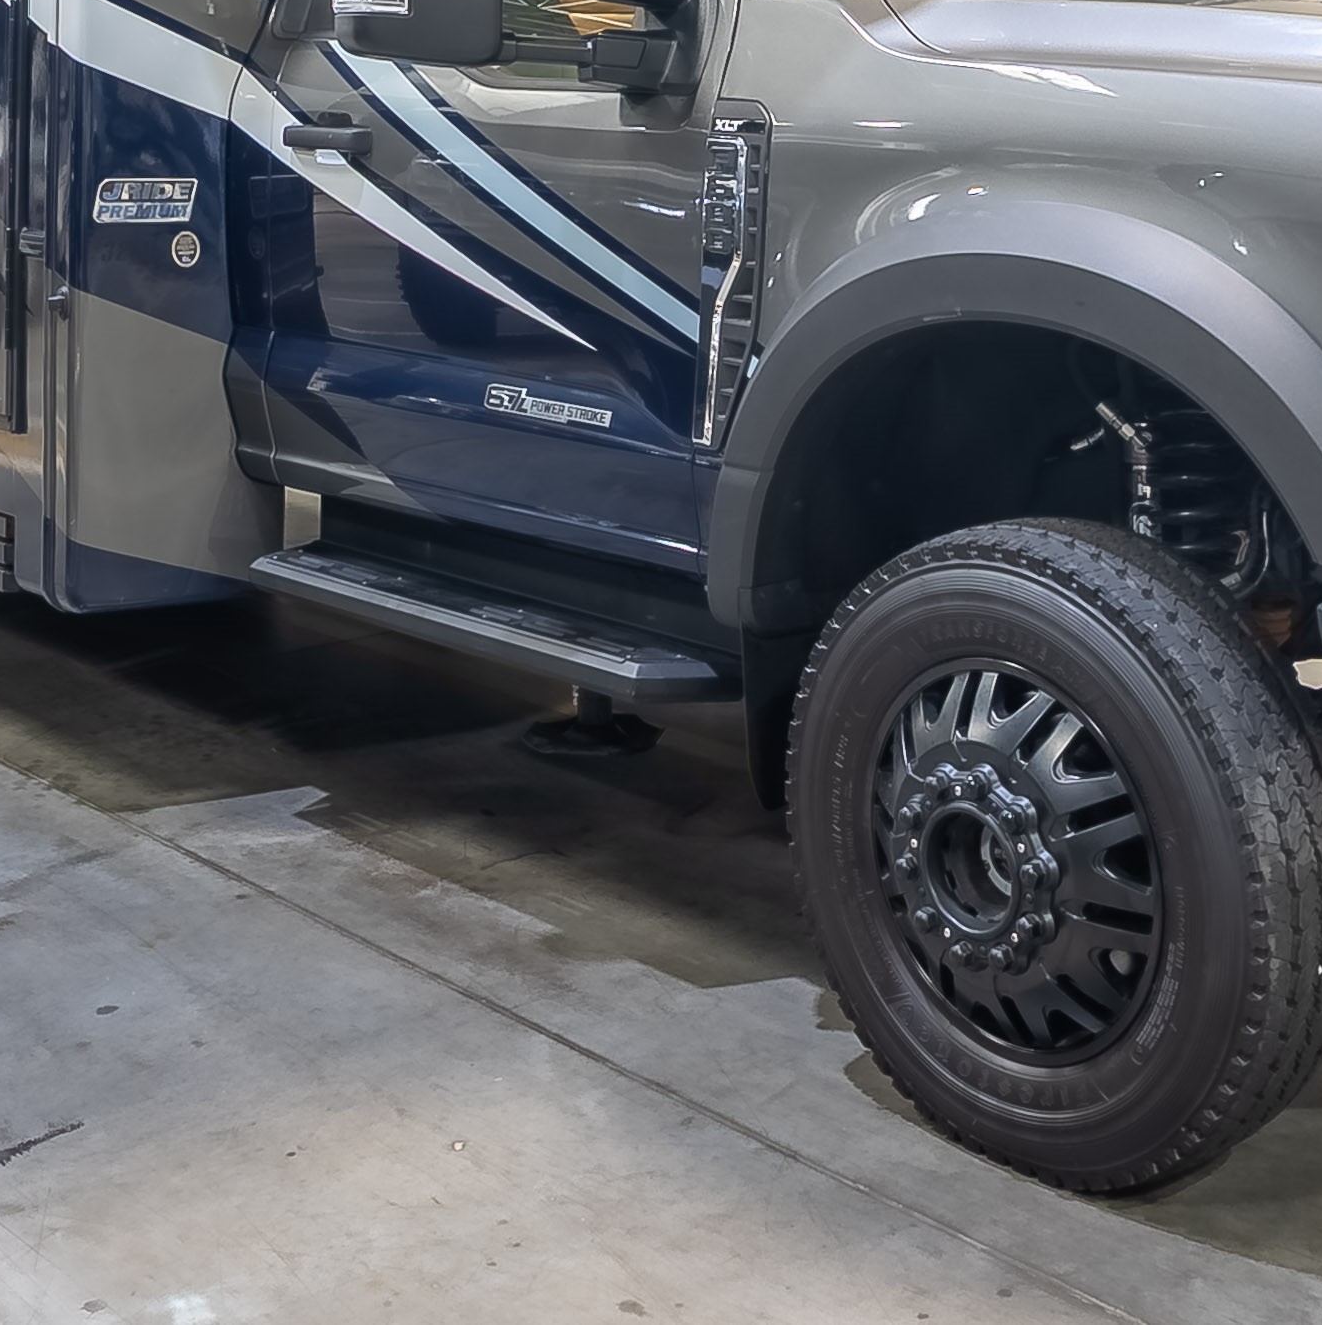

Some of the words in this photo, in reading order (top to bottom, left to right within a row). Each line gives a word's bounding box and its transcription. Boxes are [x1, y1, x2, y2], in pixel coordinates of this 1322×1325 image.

[714, 119, 742, 131] XLT
[97, 204, 190, 219] PREMIUM
[530, 399, 566, 416] POWER
[566, 406, 607, 424] STROKE
